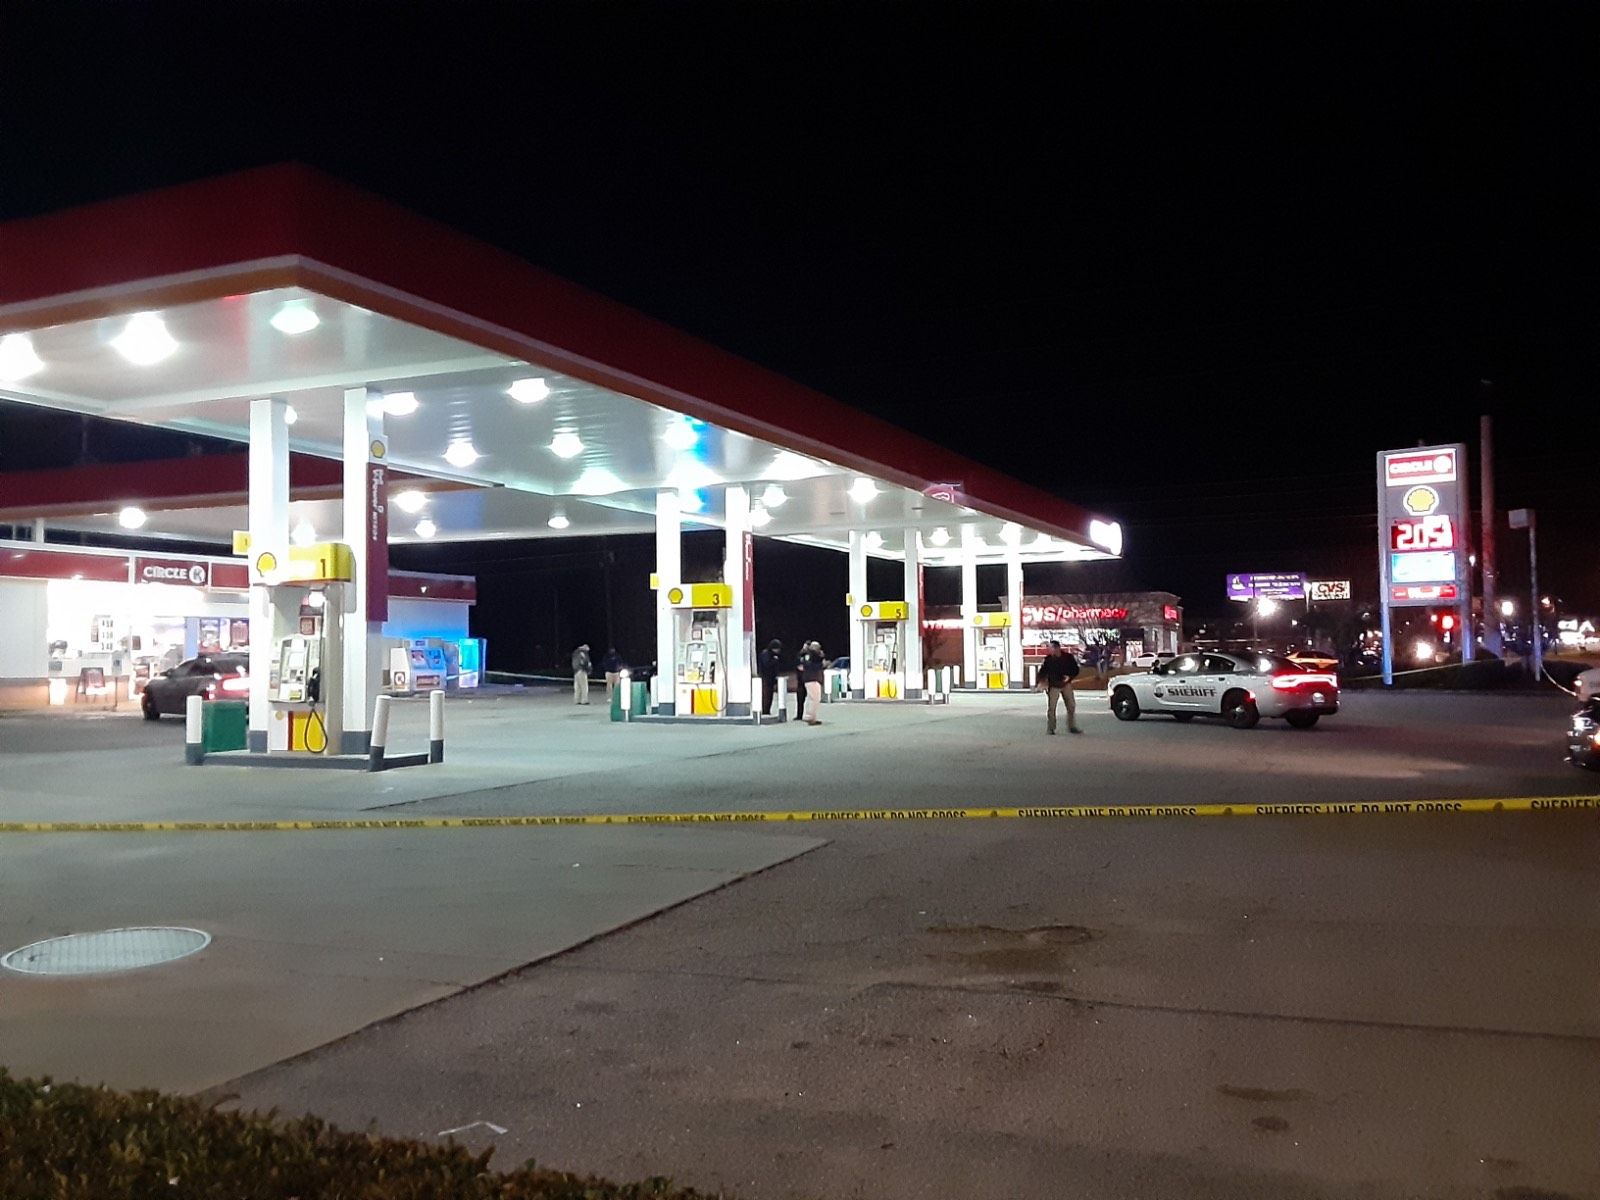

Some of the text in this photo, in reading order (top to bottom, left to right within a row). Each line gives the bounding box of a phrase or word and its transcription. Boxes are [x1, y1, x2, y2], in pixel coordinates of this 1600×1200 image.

[143, 566, 188, 579] CIRCLE
[320, 558, 326, 578] 1
[1317, 582, 1345, 593] CVS
[711, 593, 720, 606] 3
[895, 608, 902, 619] 5
[1167, 688, 1217, 697] SHERIFF
[1077, 808, 1106, 817] LINE
[1108, 808, 1125, 817] DO
[1128, 807, 1153, 817] NOT
[1156, 807, 1197, 816] CROSS
[1326, 805, 1356, 814] LINE
[1361, 804, 1380, 813] DO
[1385, 804, 1412, 813] NOT
[1416, 803, 1463, 813] CROSS
